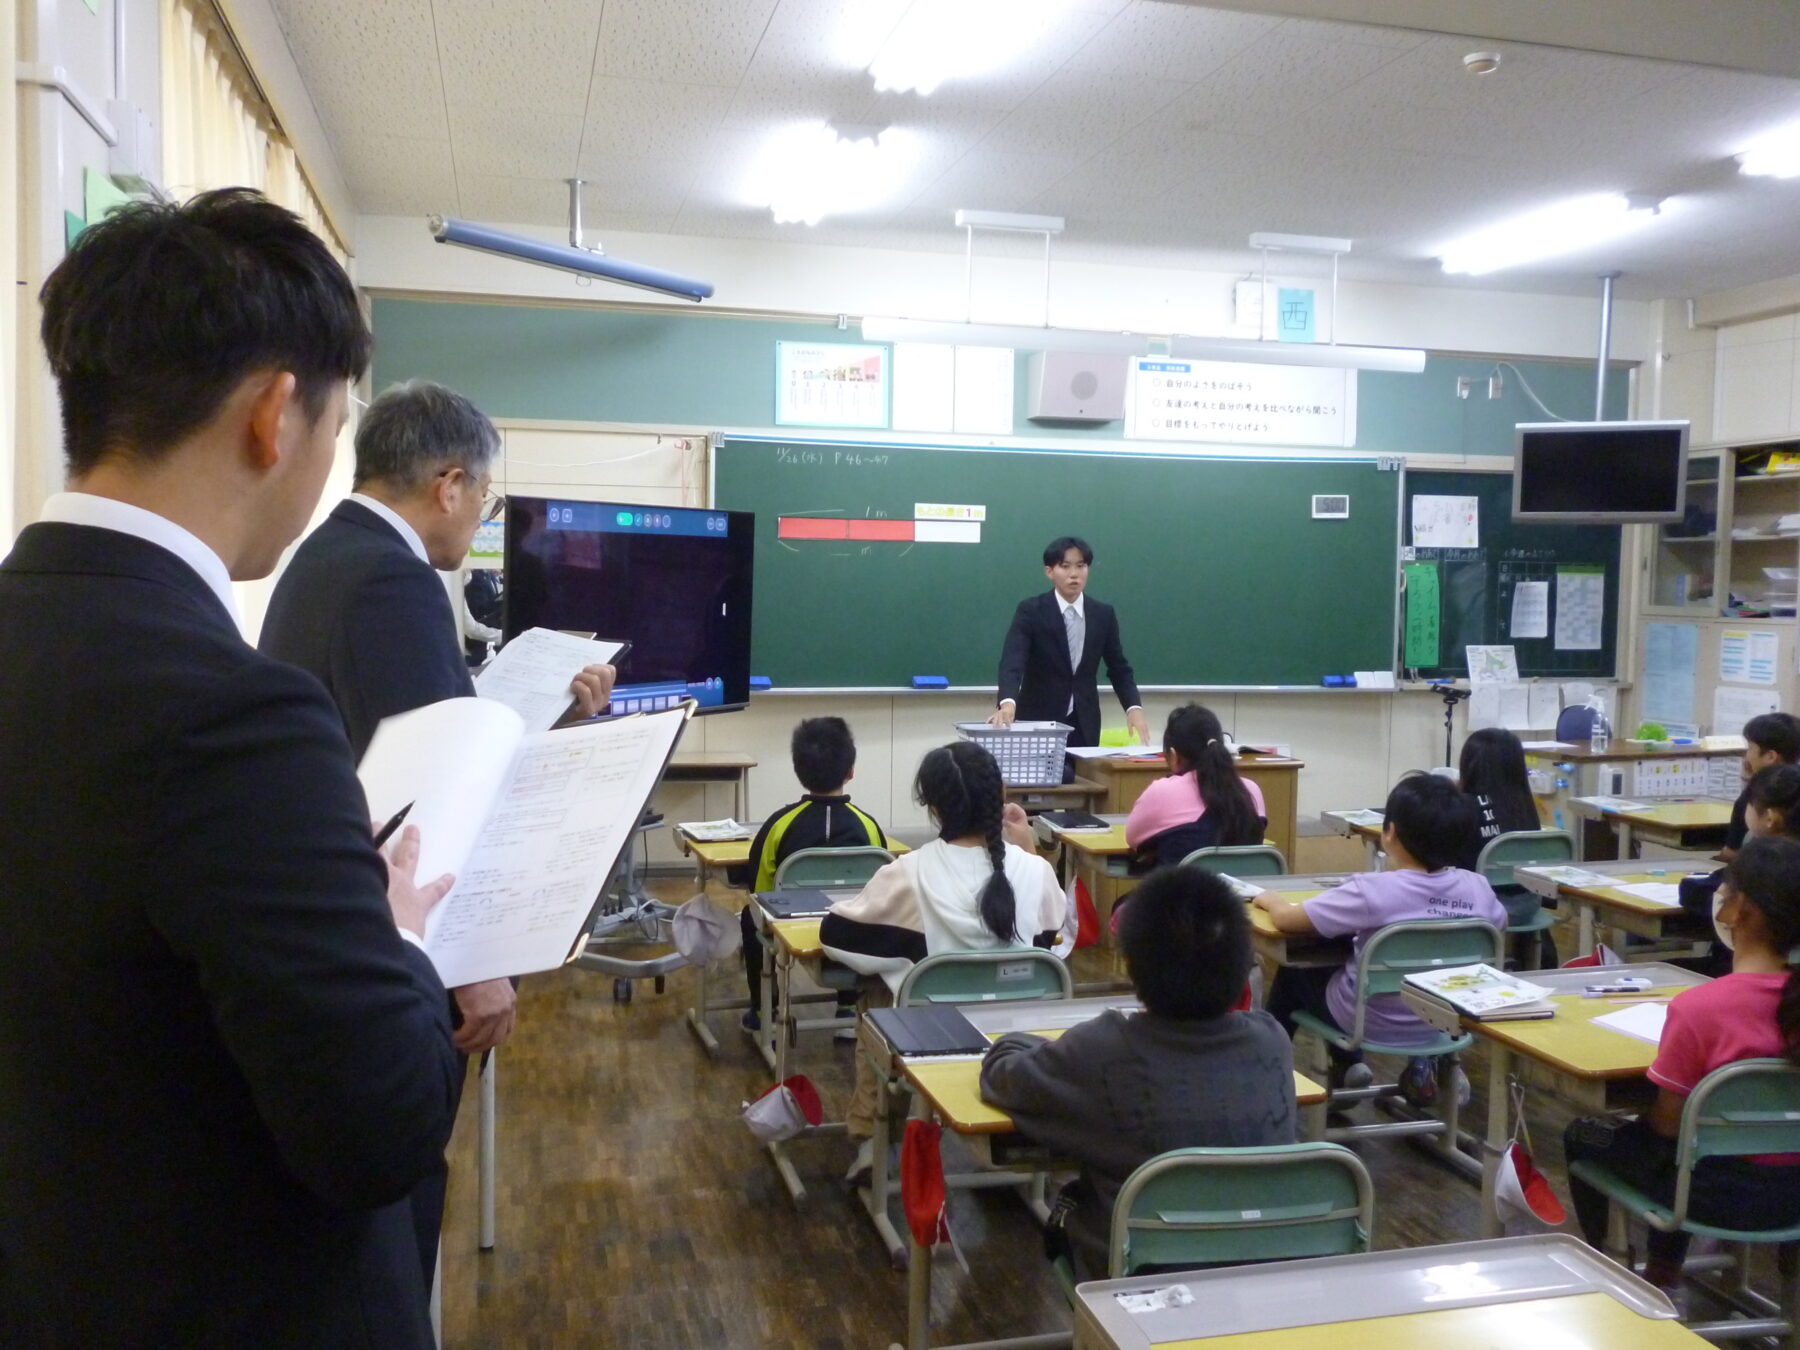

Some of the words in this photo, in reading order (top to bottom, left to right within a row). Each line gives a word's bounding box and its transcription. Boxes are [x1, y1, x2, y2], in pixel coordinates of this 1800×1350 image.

[1282, 301, 1308, 331] 西
[1166, 378, 1253, 392] 自分のよさをのばそう
[1166, 399, 1338, 416] 友達の考えと自分の考えを比べながら聞こう
[1165, 419, 1269, 433] 目標をもってやりとげよう
[1429, 897, 1449, 906] one
[1451, 899, 1474, 911] play
